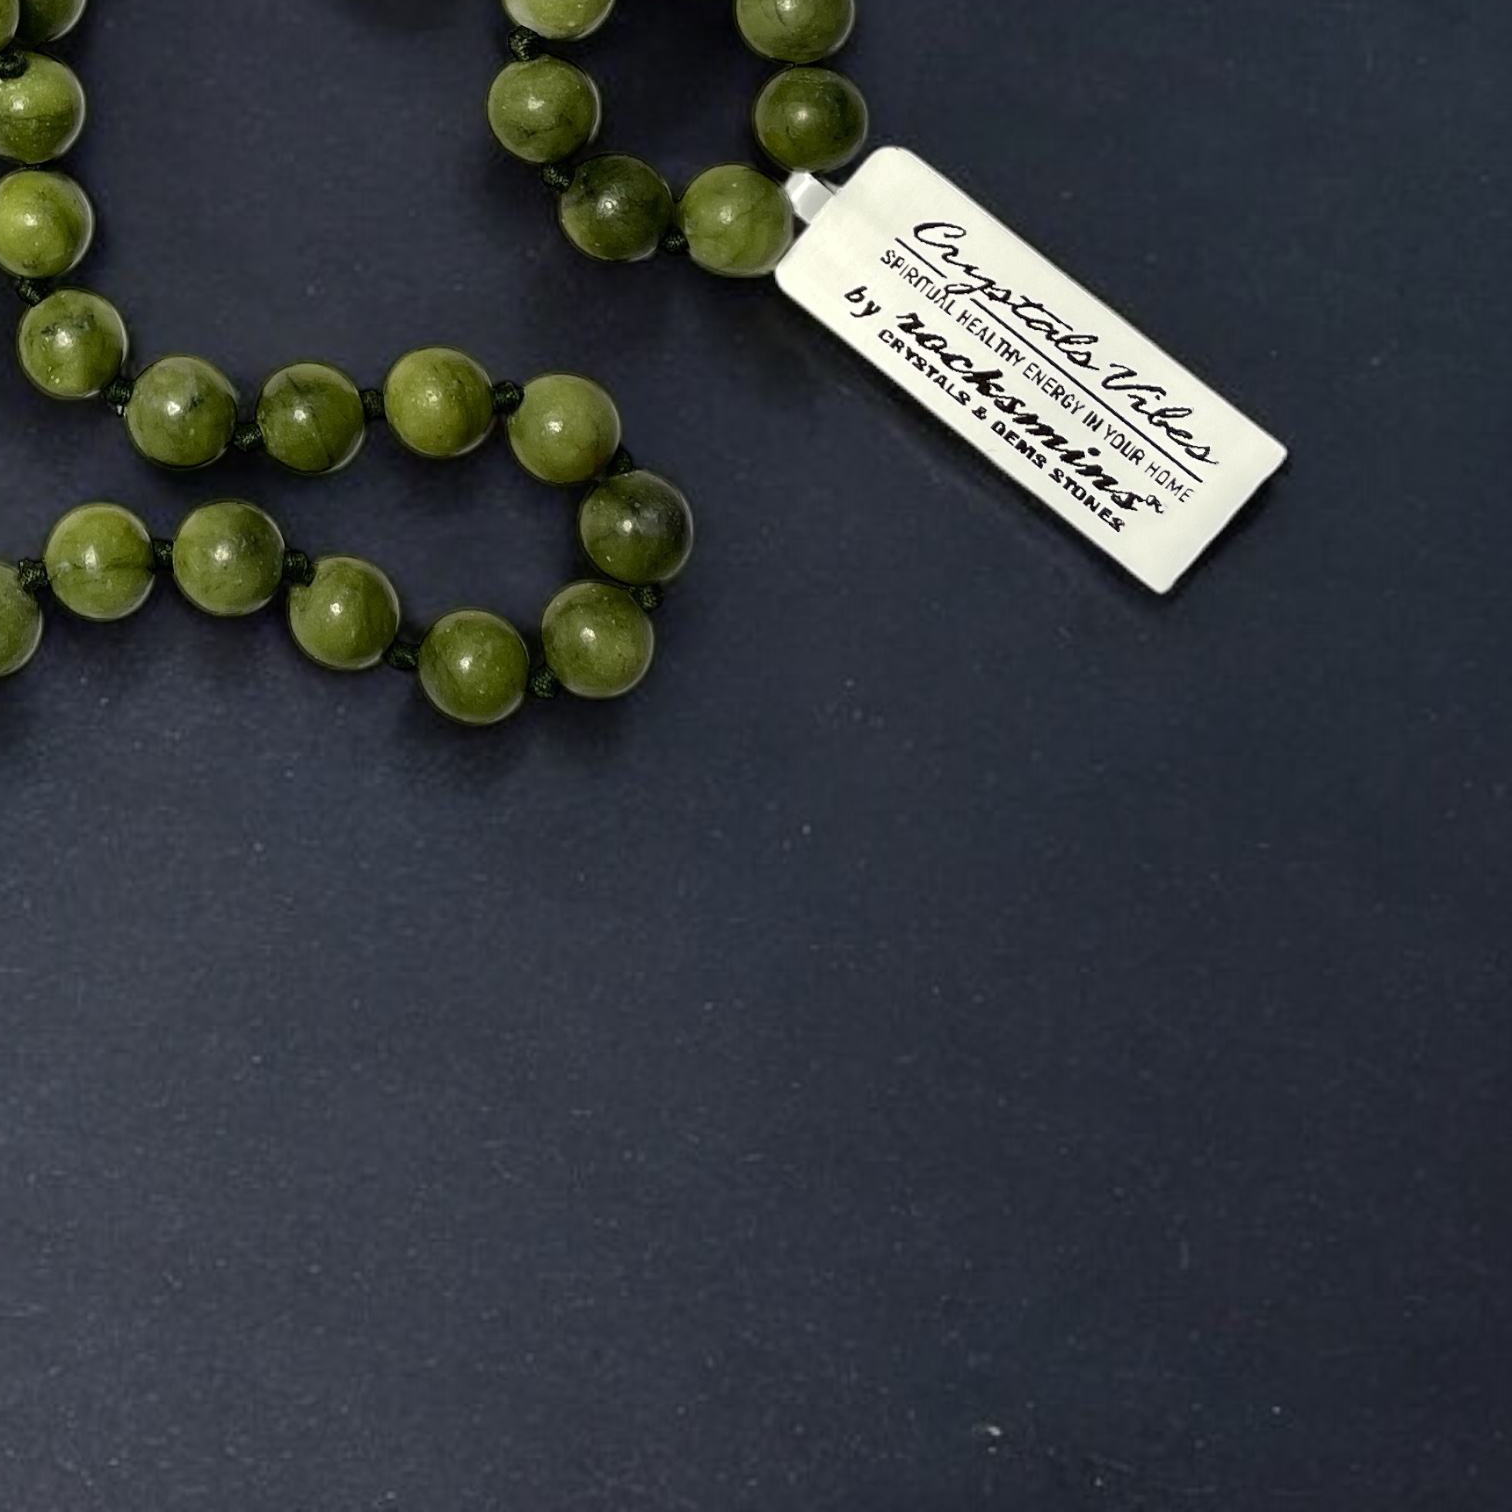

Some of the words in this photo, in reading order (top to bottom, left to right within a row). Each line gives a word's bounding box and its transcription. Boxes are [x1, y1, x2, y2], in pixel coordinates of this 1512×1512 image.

[844, 285, 882, 318] by
[880, 249, 956, 316] SPIRITUAL
[955, 309, 1026, 367] HEALTHY
[1022, 362, 1086, 415] ENERGY
[1082, 410, 1104, 433] IN
[1103, 423, 1146, 466] YOUR
[1144, 462, 1194, 503] HOME
[913, 222, 1100, 371] Crystals
[1101, 363, 1219, 465] Vibes
[878, 329, 971, 406] CRYSTALS
[971, 406, 988, 421] &
[1048, 467, 1125, 533] STONES
